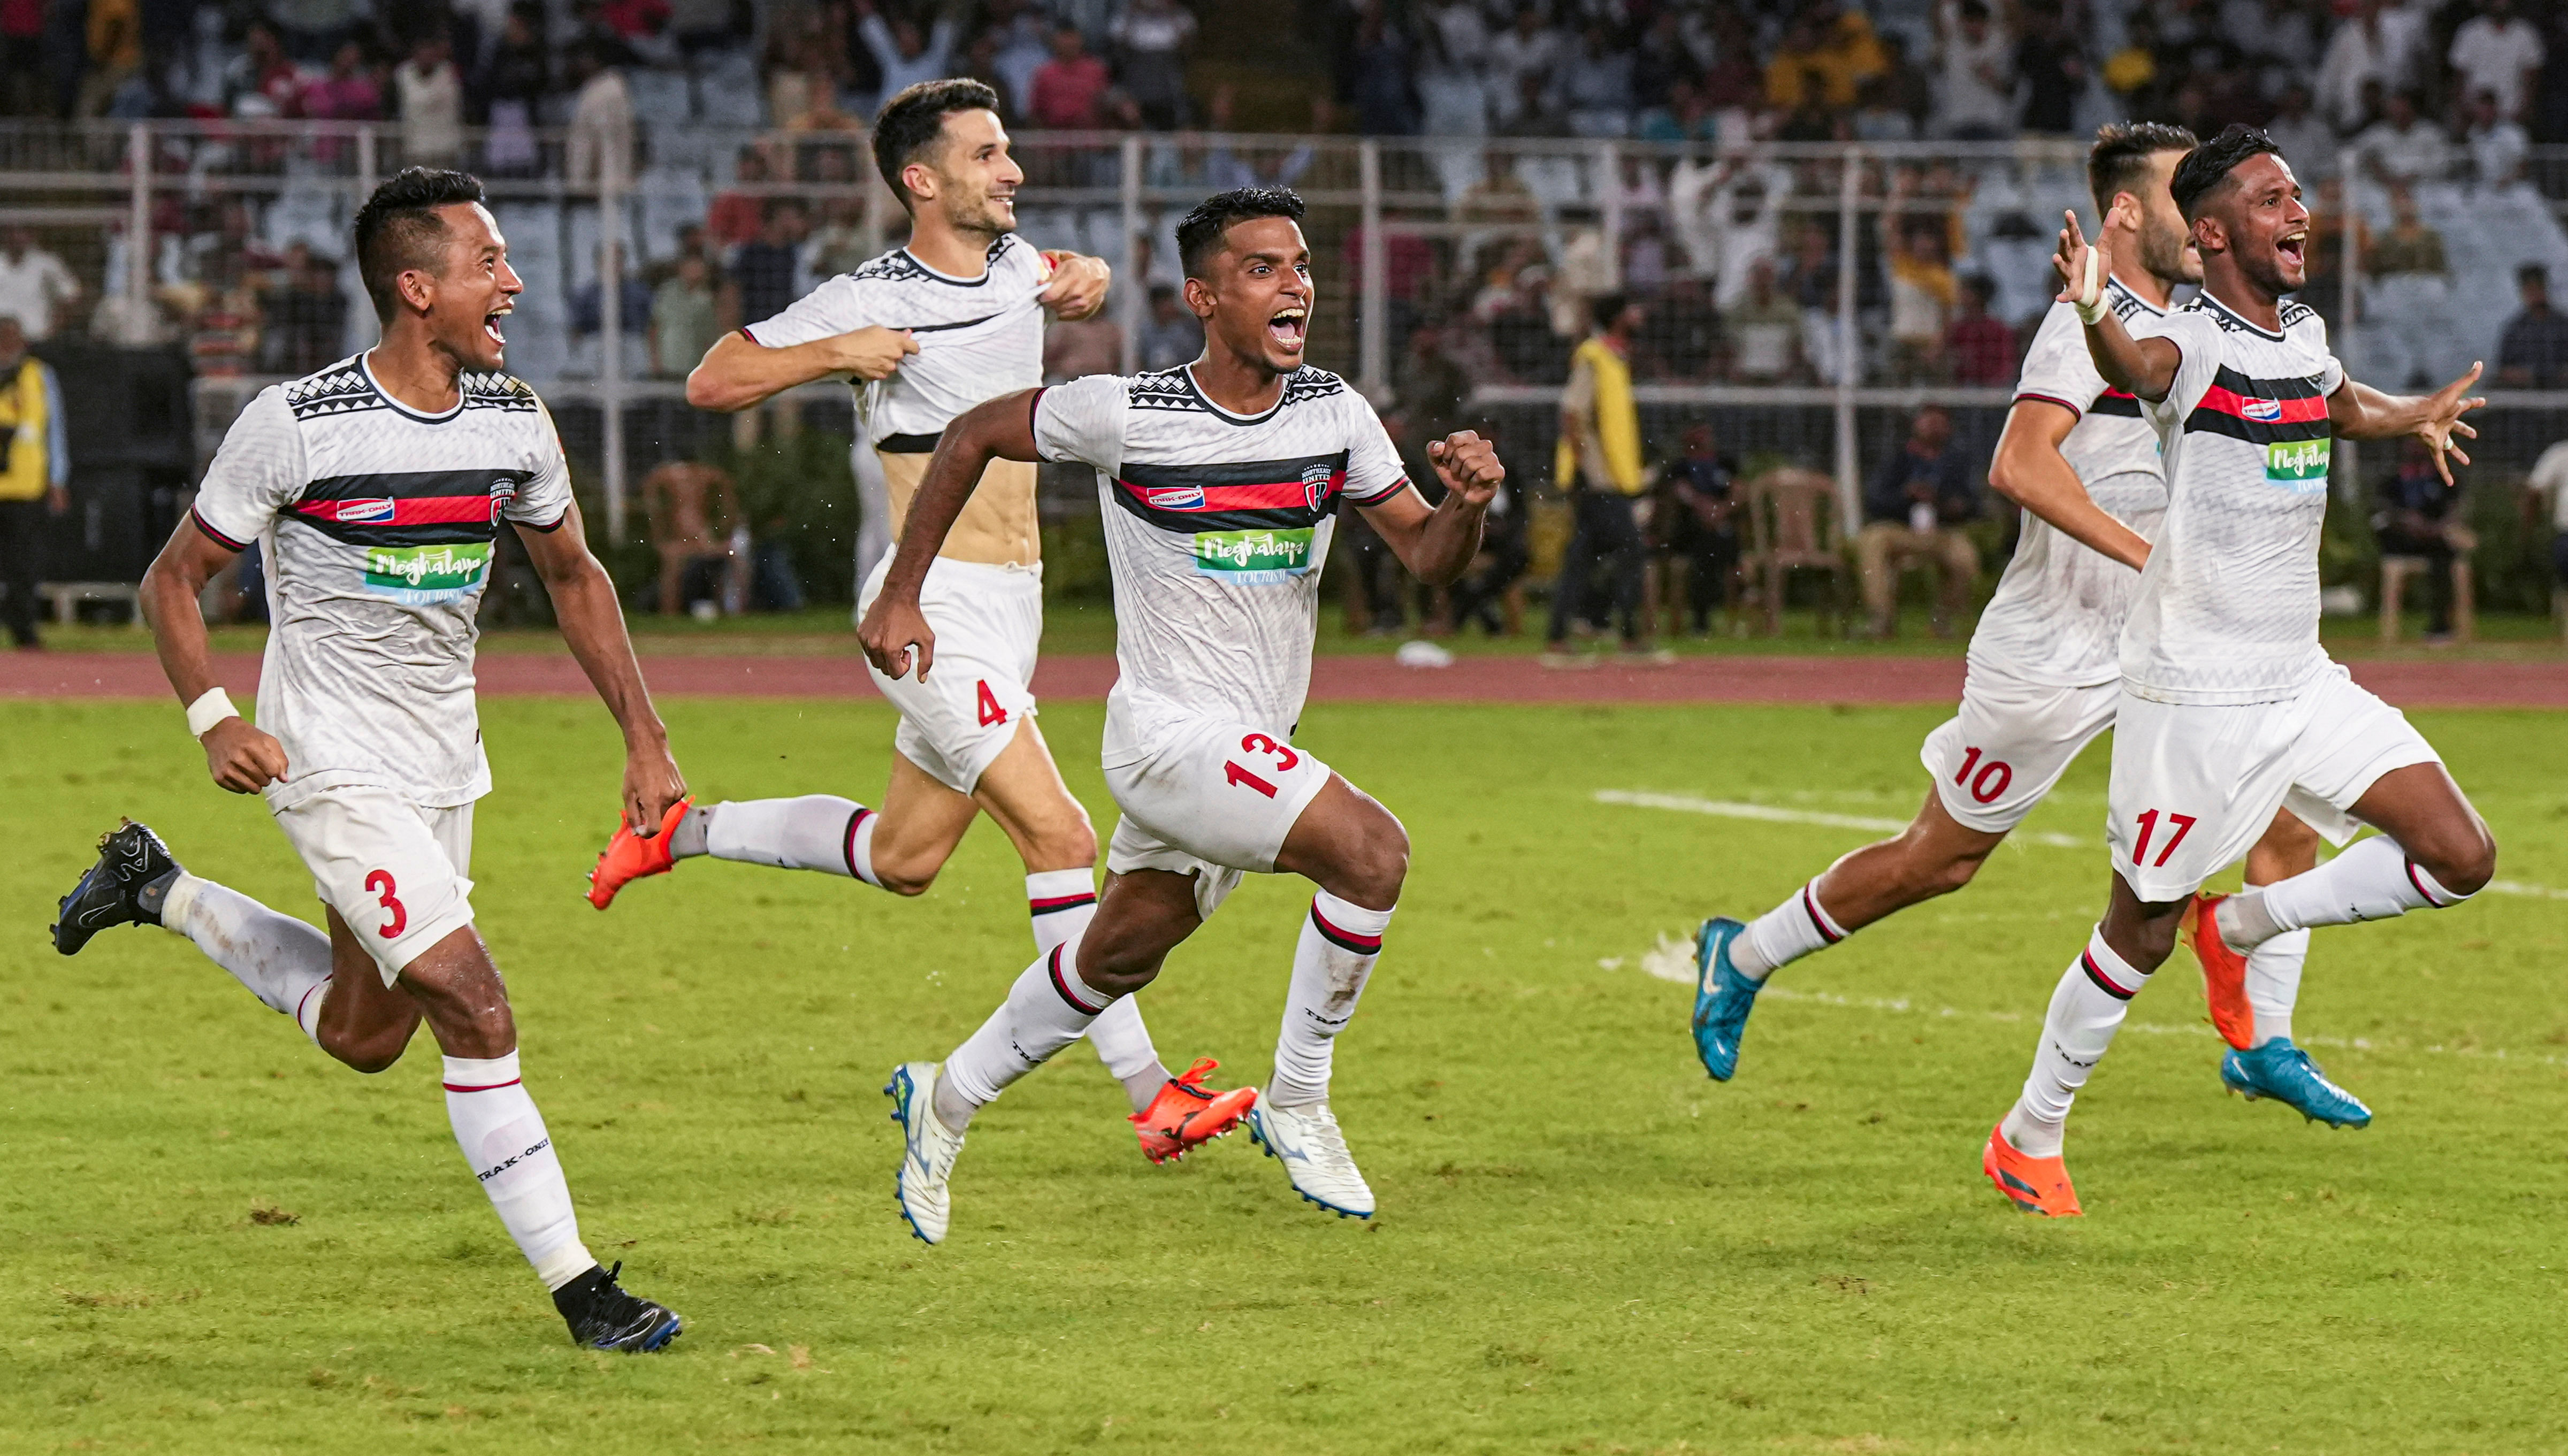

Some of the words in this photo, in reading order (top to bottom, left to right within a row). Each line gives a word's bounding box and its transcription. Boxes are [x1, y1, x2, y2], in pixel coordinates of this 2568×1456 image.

[2274, 443, 2330, 477] Meghalay
[1303, 474, 1331, 485] UNITED
[338, 503, 392, 517] TRAK-ONLY
[1151, 492, 1201, 503] TRAK-ONLY
[1205, 533, 1306, 567] Meghalaya
[1234, 570, 1286, 584] TOURISM
[977, 679, 1007, 727] 4
[1224, 733, 1299, 799] 13
[1955, 746, 2012, 803] 10
[2133, 808, 2197, 867] 17
[365, 869, 407, 939] 3
